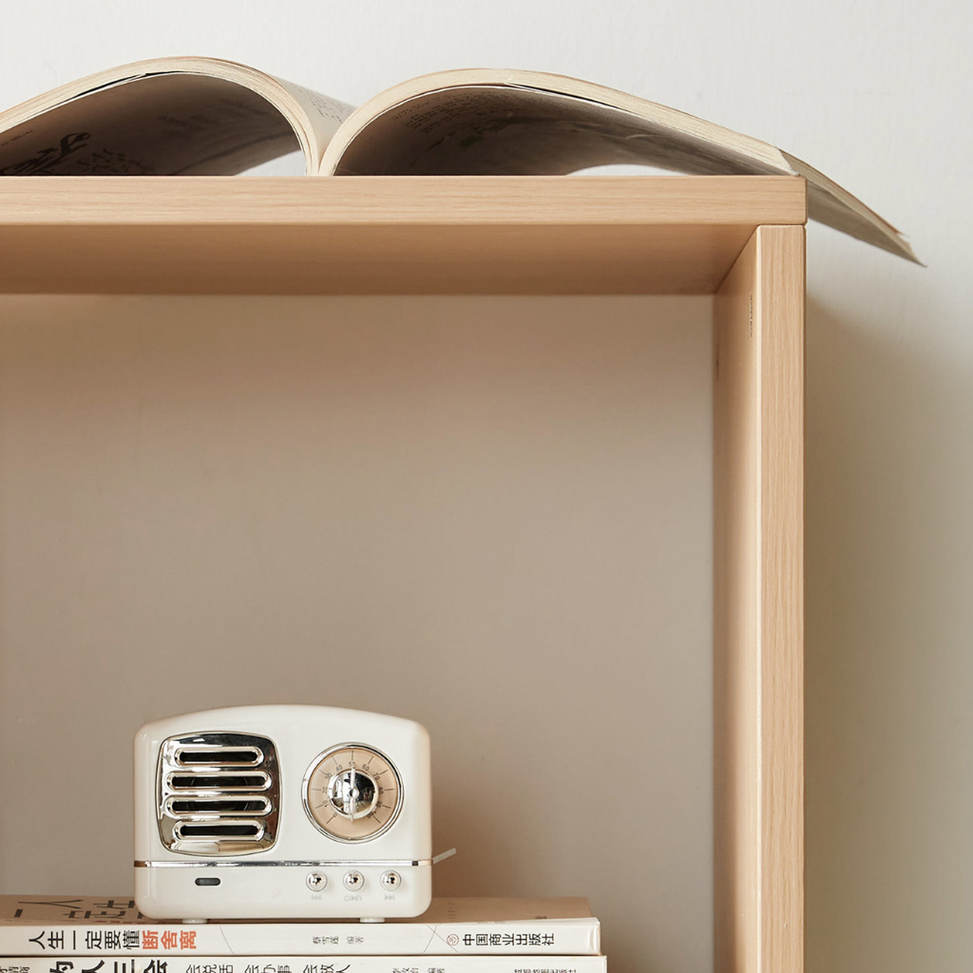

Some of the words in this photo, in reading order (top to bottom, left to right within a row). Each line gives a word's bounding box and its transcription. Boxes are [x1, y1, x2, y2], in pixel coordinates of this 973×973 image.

[29, 930, 197, 950] 人生一定要懂断舍离
[462, 933, 555, 946] 中国商业出版社
